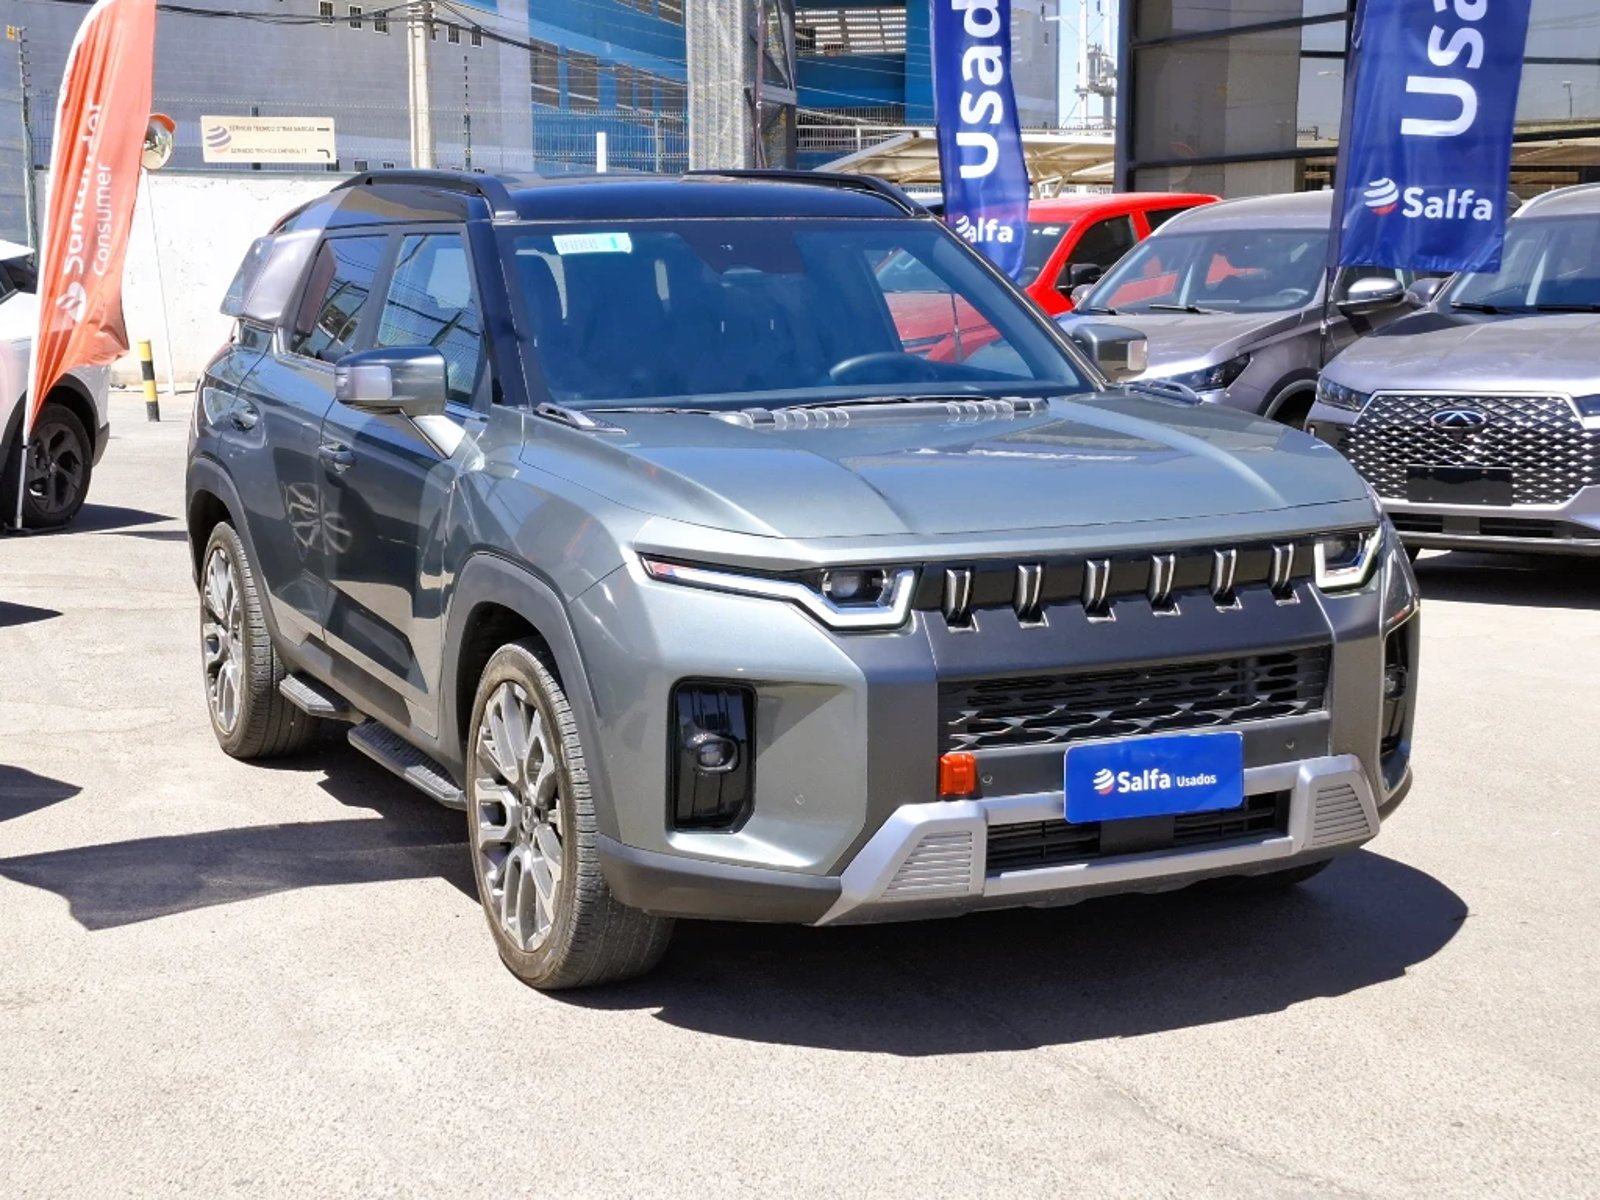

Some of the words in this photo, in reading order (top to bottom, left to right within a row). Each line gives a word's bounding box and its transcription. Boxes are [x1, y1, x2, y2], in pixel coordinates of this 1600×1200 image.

[951, 0, 1004, 179] Usad
[63, 102, 103, 276] Saner
[92, 163, 112, 277] Consumer
[1402, 187, 1493, 221] Salfa
[963, 217, 1014, 243] alfa
[1117, 768, 1171, 793] Salfa
[1176, 773, 1217, 788] Usados
